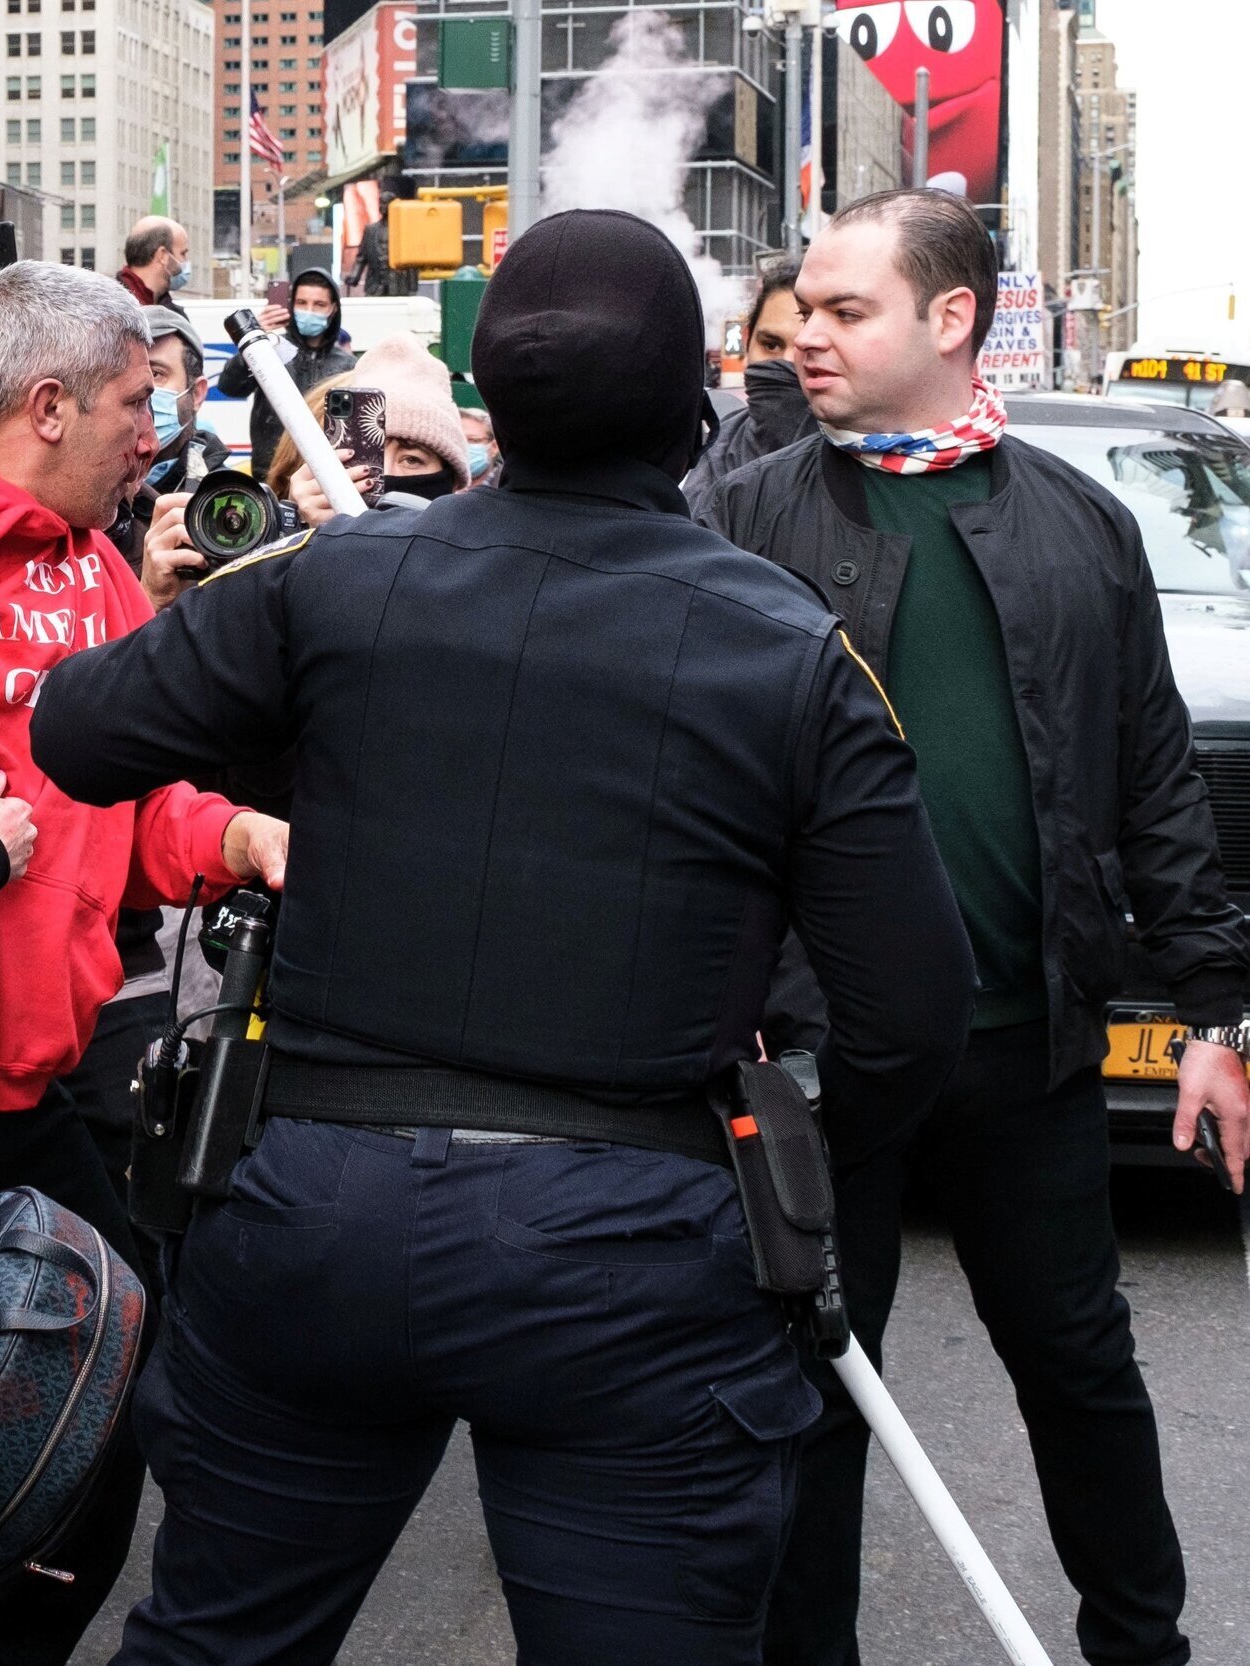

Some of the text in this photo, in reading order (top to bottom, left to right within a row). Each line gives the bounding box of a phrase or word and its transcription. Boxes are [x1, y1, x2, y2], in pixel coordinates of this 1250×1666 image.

[998, 275, 1036, 288] NLY
[996, 289, 1038, 309] ESUS
[996, 310, 1042, 325] RGIVES
[990, 326, 1030, 338] SIN &
[983, 338, 1038, 352] SAVES
[981, 352, 1043, 369] REPENT
[1204, 363, 1227, 382] ST
[1128, 1028, 1188, 1065] JL4
[1143, 1065, 1178, 1077] EMPI
[966, 1575, 988, 1606] EAGLE
